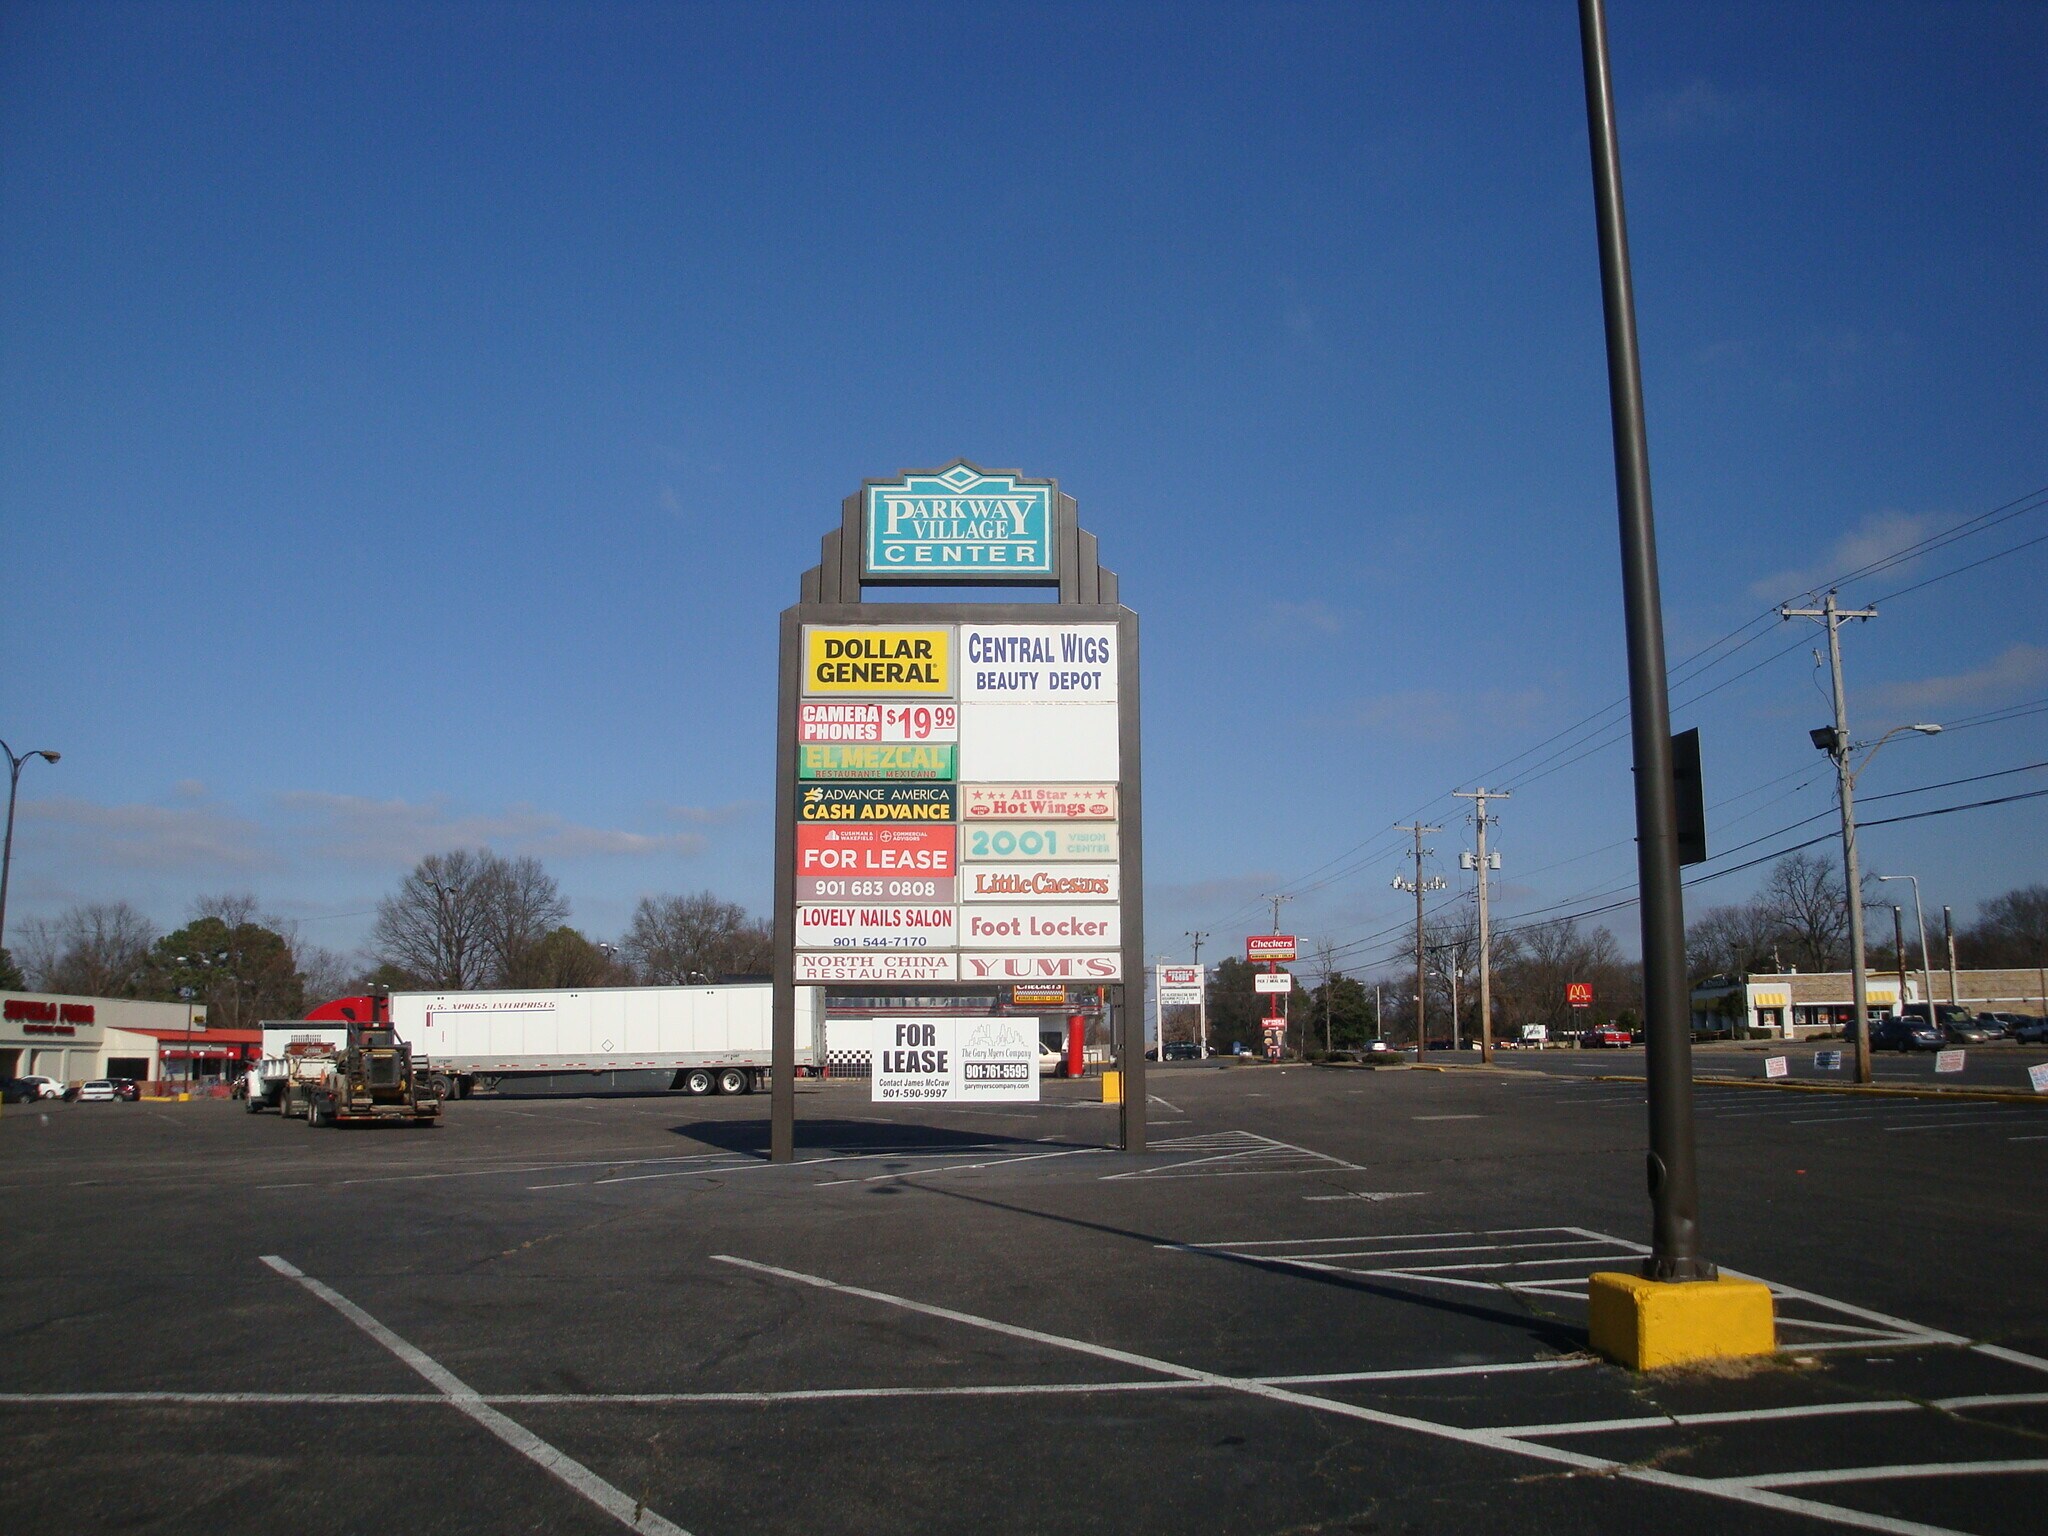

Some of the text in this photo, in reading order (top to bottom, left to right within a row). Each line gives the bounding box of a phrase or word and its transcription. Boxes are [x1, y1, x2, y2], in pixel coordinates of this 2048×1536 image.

[883, 500, 1036, 535] PARKWAY
[913, 520, 1008, 539] VILLAGE
[885, 546, 1035, 562] CENTER
[825, 639, 932, 659] DOLLAR
[969, 633, 1109, 663] CENTRAL WIGS
[816, 663, 939, 683] GENERAL
[976, 672, 1101, 690] BEAUTY DEPOT
[802, 705, 880, 722] CAMERA
[804, 724, 878, 740] PHONES
[806, 747, 945, 769] EL MEZCAL
[816, 770, 881, 778] RESTAURANTE
[825, 789, 949, 800] ADVANCE AMERICA
[1011, 789, 1067, 800] All Star
[803, 804, 950, 820] CASH ADVANCE
[993, 801, 1085, 817] Hot Wings
[972, 830, 1106, 855] 2001 VISION
[1067, 845, 1110, 853] CENTER
[804, 849, 947, 869] FOR LEASE
[815, 880, 935, 896] 901 683 0808
[803, 908, 952, 927] LOVELY NAILS SALON
[971, 917, 1108, 936] Foot Locker
[833, 936, 927, 947] 901 544-7170
[1251, 940, 1292, 948] Checkers
[803, 956, 949, 967] NORTH CHINA
[969, 958, 1116, 976] YUM'S
[807, 968, 939, 978] RESTAURANT
[492, 1001, 555, 1009] ENTERPRISES
[896, 1024, 936, 1046] FOR
[883, 1050, 948, 1073] LEASE
[962, 1048, 1032, 1059] The Gary Myers Company
[966, 1064, 1028, 1078] 901-761-5595
[879, 1078, 950, 1087] Contact James McCraw
[883, 1089, 947, 1098] 901-590-9997
